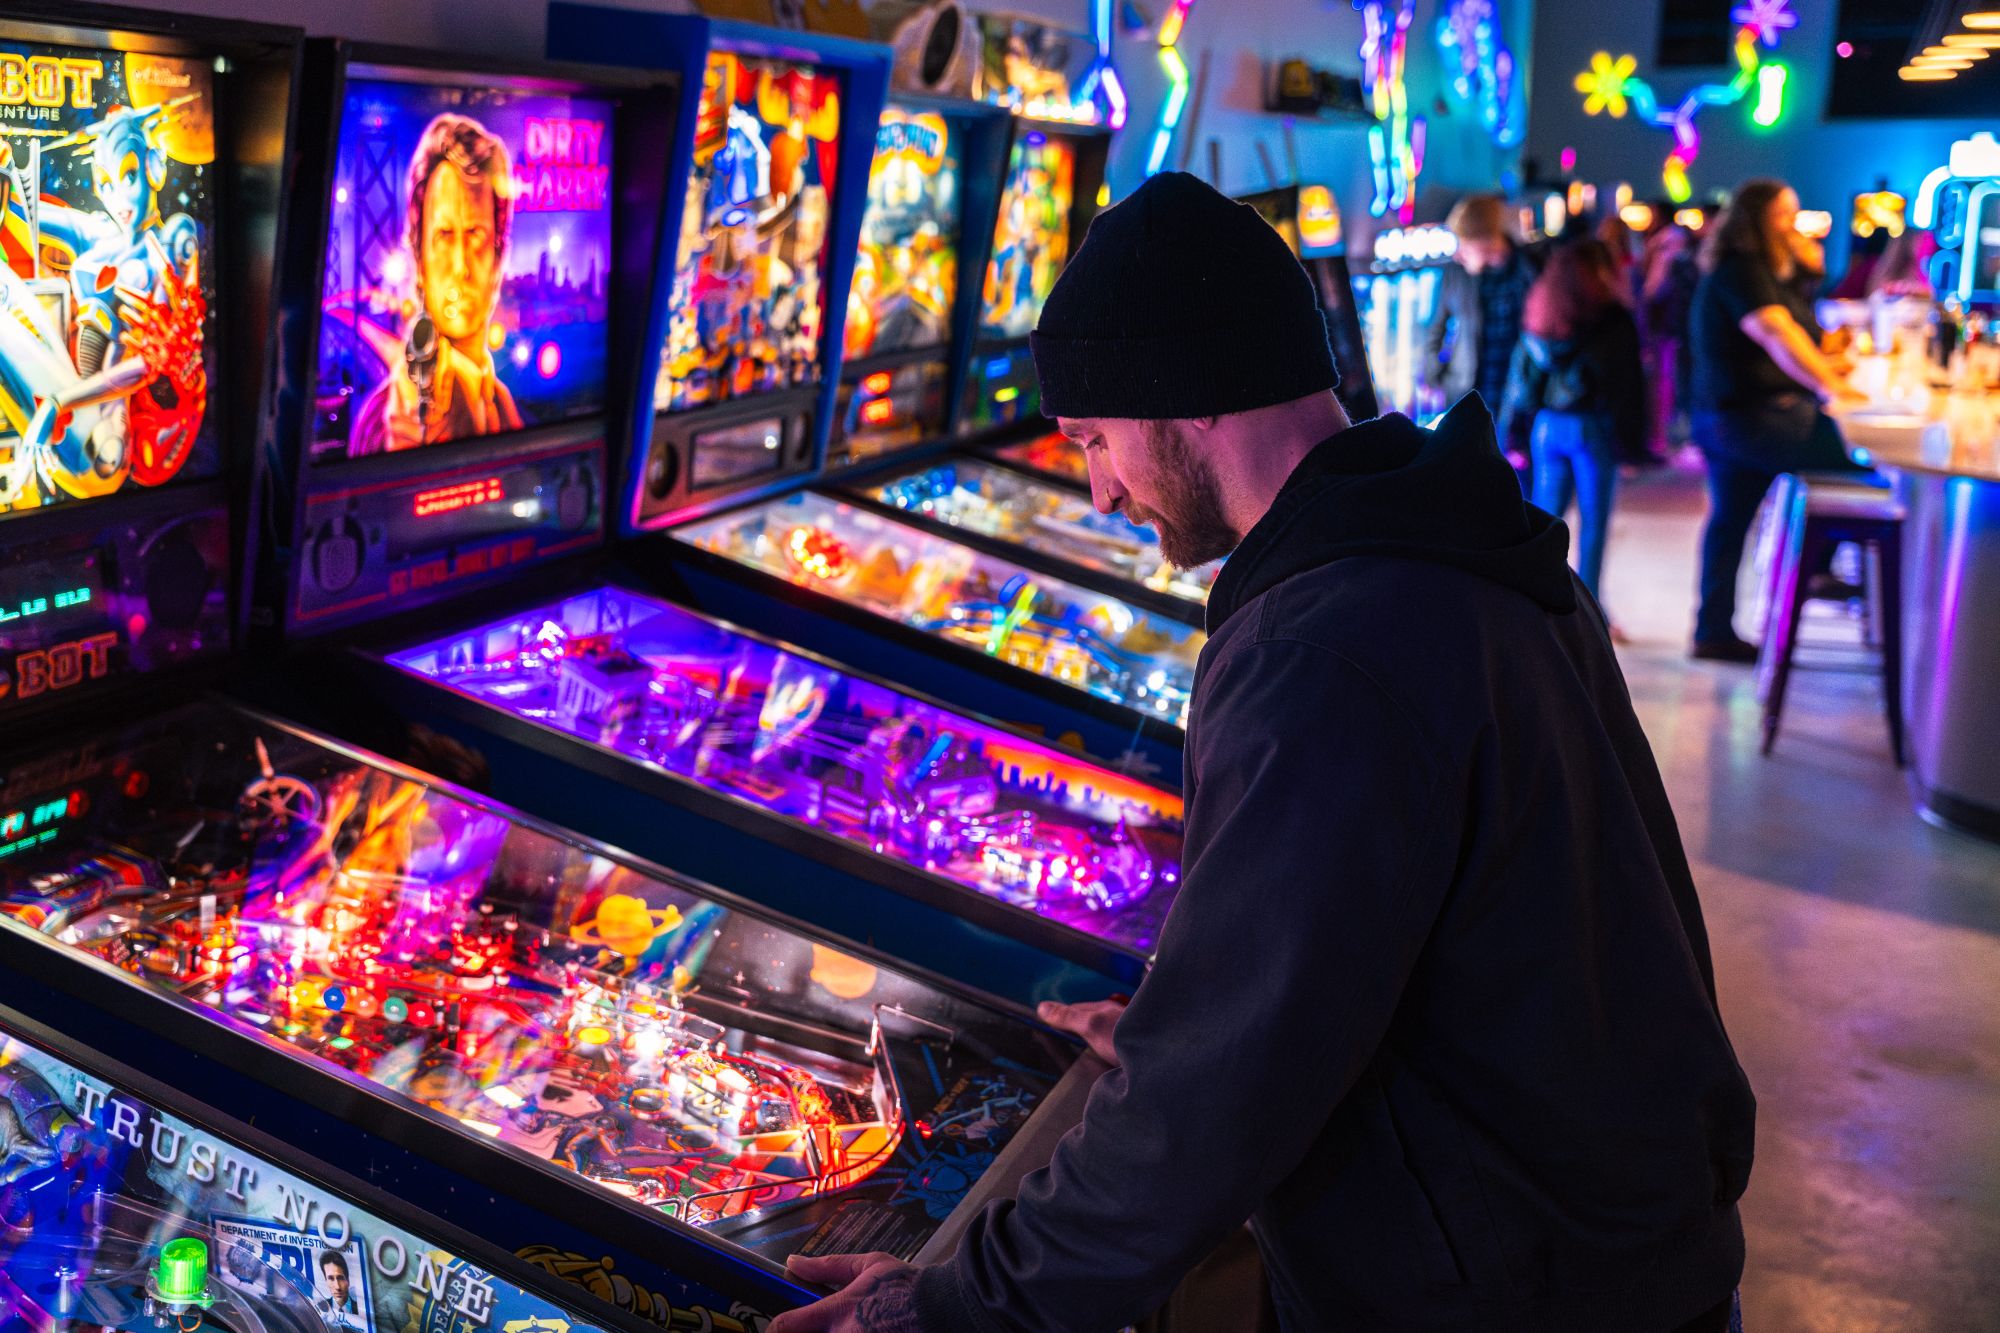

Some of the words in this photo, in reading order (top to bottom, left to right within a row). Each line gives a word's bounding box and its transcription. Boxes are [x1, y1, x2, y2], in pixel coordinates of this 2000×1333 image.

[0, 53, 103, 109] BOT
[0, 105, 60, 121] NTURE
[523, 116, 605, 166] DIRTY
[512, 164, 608, 212] HARRY
[16, 630, 118, 699] BOT
[74, 1080, 257, 1201] TRUST
[273, 1183, 350, 1248] NO
[373, 1235, 494, 1323] ONE
[220, 1224, 277, 1241] DEPARTMENT
[279, 1234, 288, 1243] of
